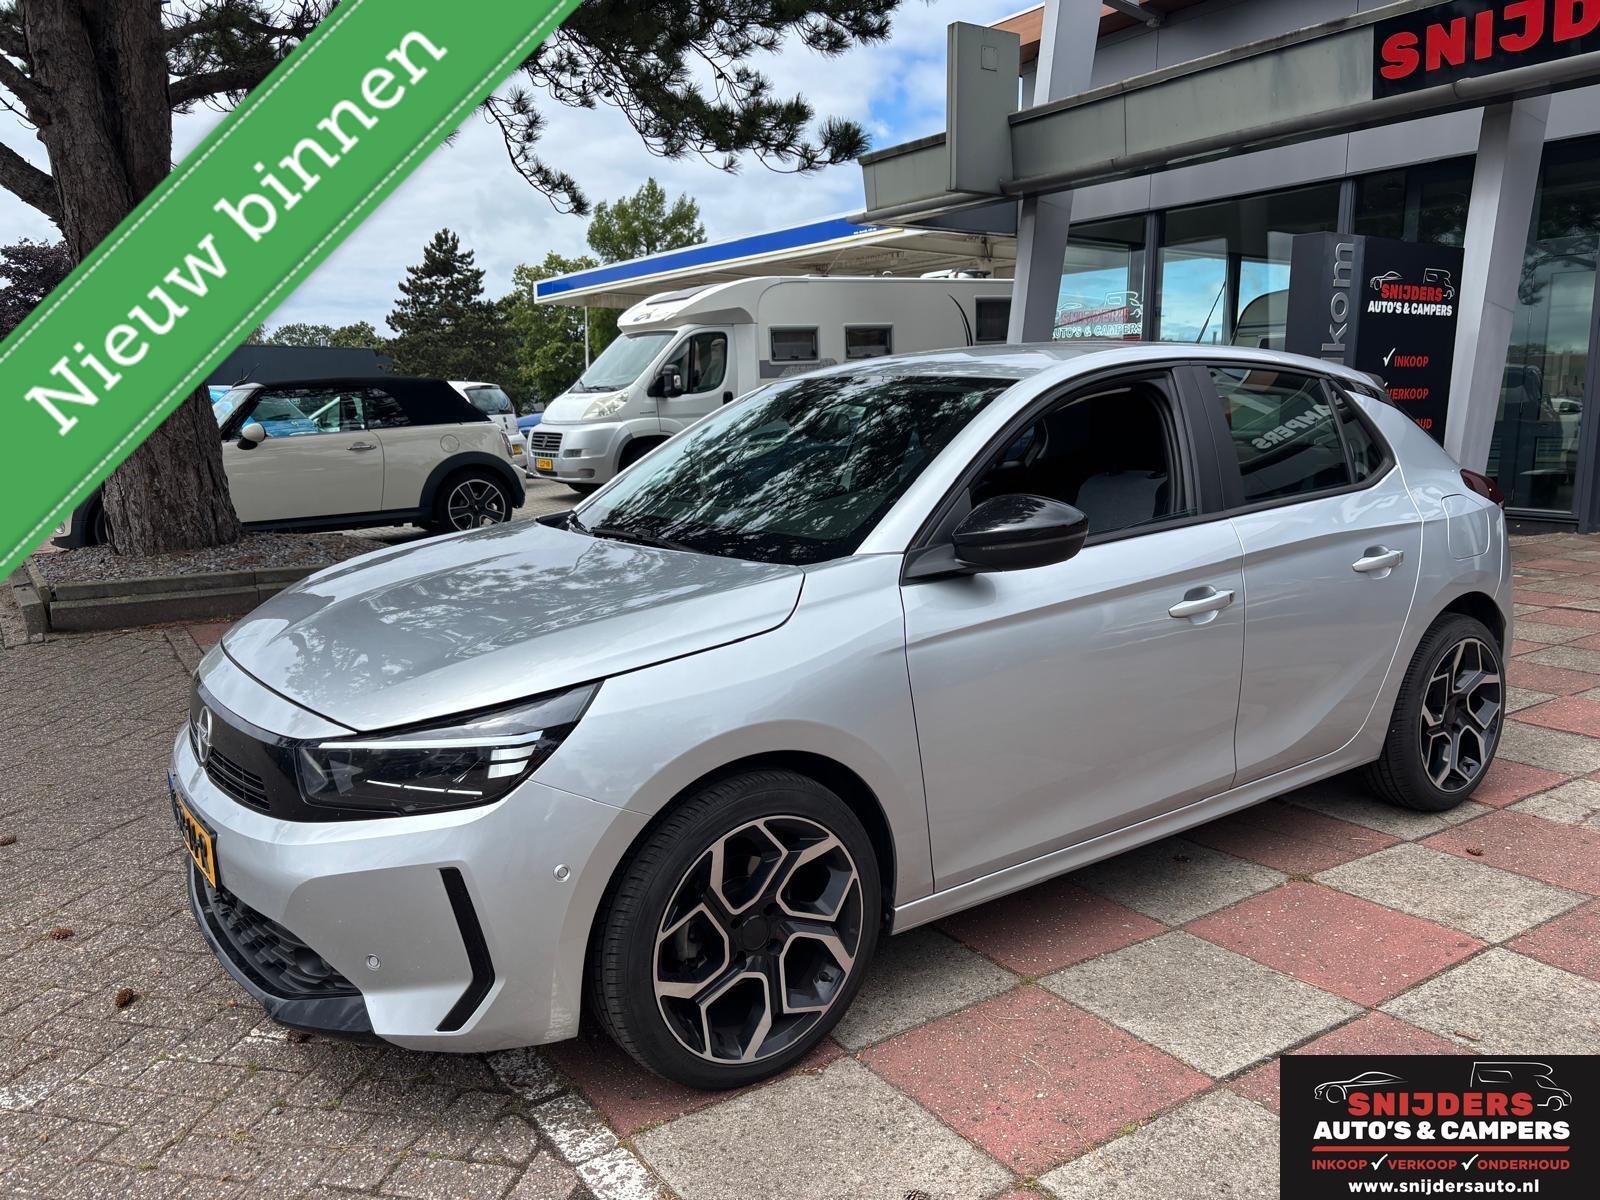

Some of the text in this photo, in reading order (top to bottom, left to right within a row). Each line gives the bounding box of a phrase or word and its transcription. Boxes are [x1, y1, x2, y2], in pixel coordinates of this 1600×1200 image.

[1380, 0, 1600, 79] SNIJD
[1381, 283, 1443, 302] SNIJDERS
[1367, 300, 1452, 316] AUTO'S & CAMPERS
[1094, 322, 1142, 336] CAMPERS
[1394, 356, 1429, 367] INKOOP
